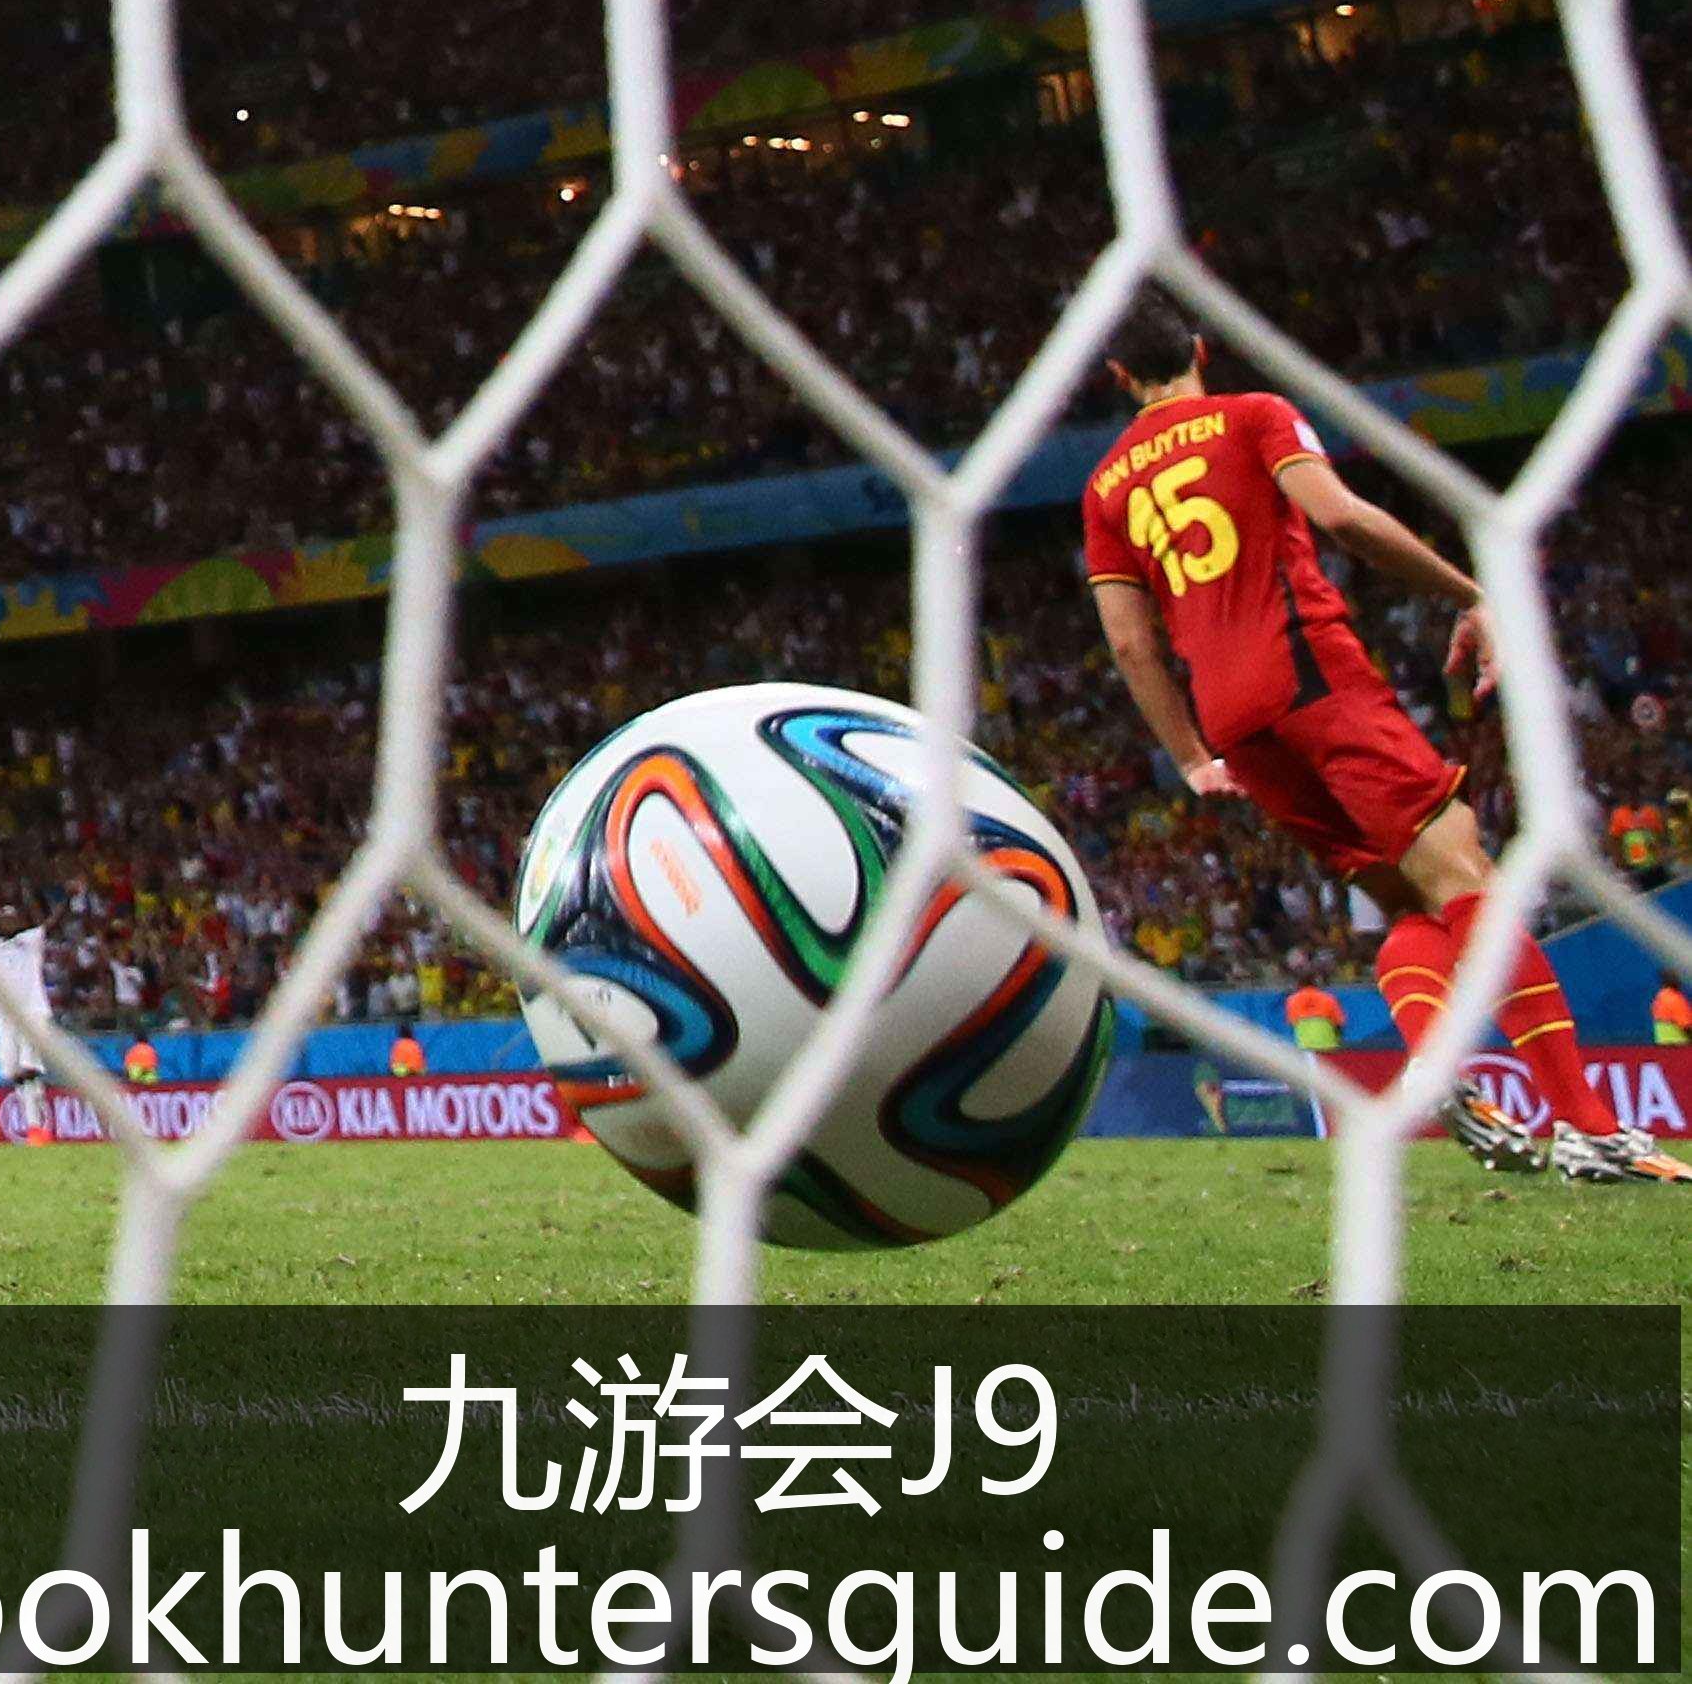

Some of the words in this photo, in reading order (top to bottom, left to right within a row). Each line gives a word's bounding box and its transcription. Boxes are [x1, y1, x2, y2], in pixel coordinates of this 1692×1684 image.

[1128, 411, 1226, 473] BUYTEN
[1127, 454, 1240, 598] 15
[336, 1086, 401, 1137] KIA
[404, 1081, 560, 1137] MOTORS
